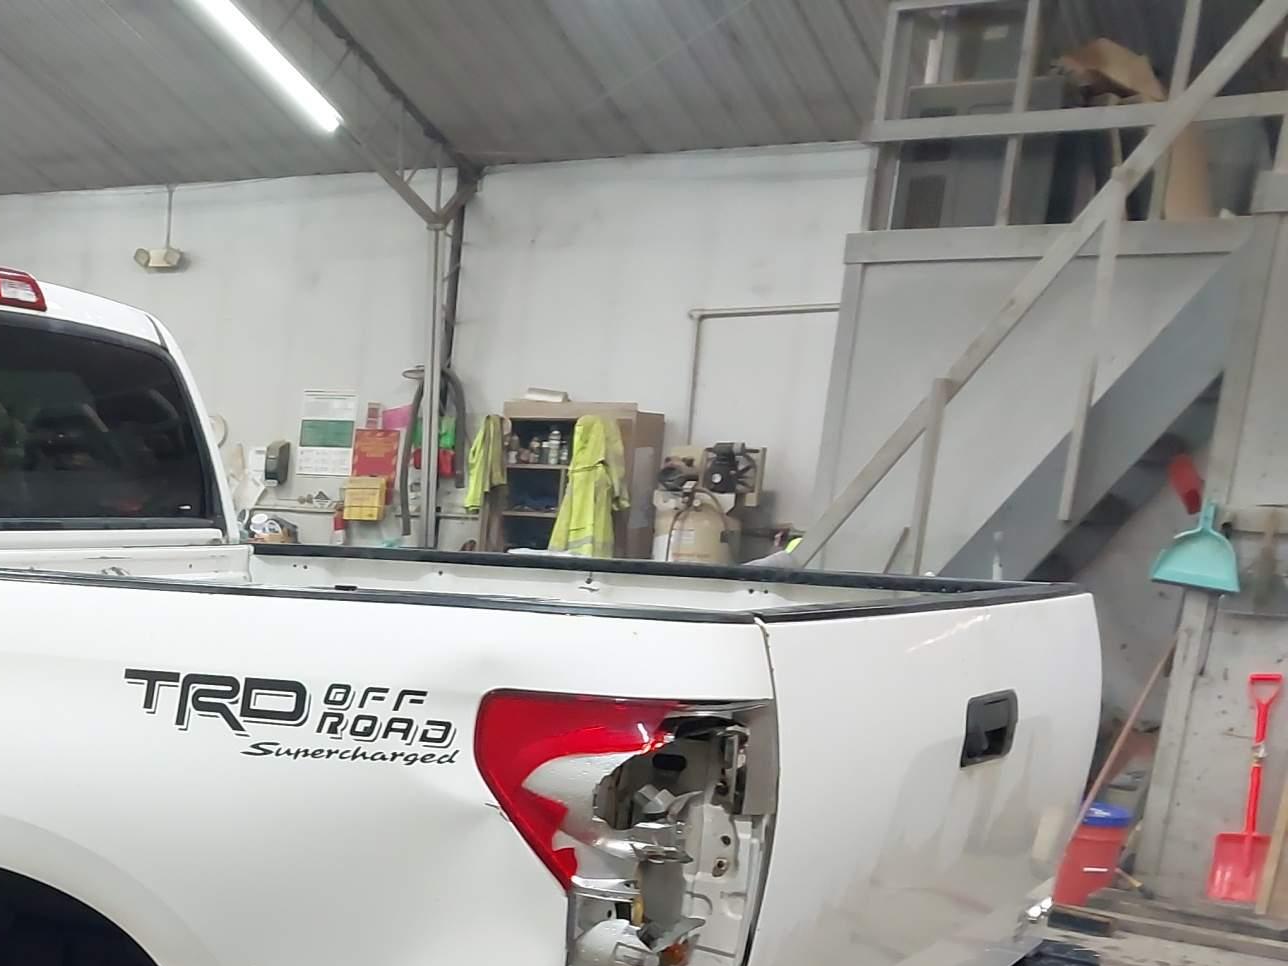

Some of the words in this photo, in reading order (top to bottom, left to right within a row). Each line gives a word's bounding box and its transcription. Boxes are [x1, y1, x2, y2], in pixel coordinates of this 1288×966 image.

[123, 667, 310, 735] TRD
[322, 683, 429, 712] OFF
[315, 711, 457, 748] ROAD
[239, 741, 461, 766] Supercharged
